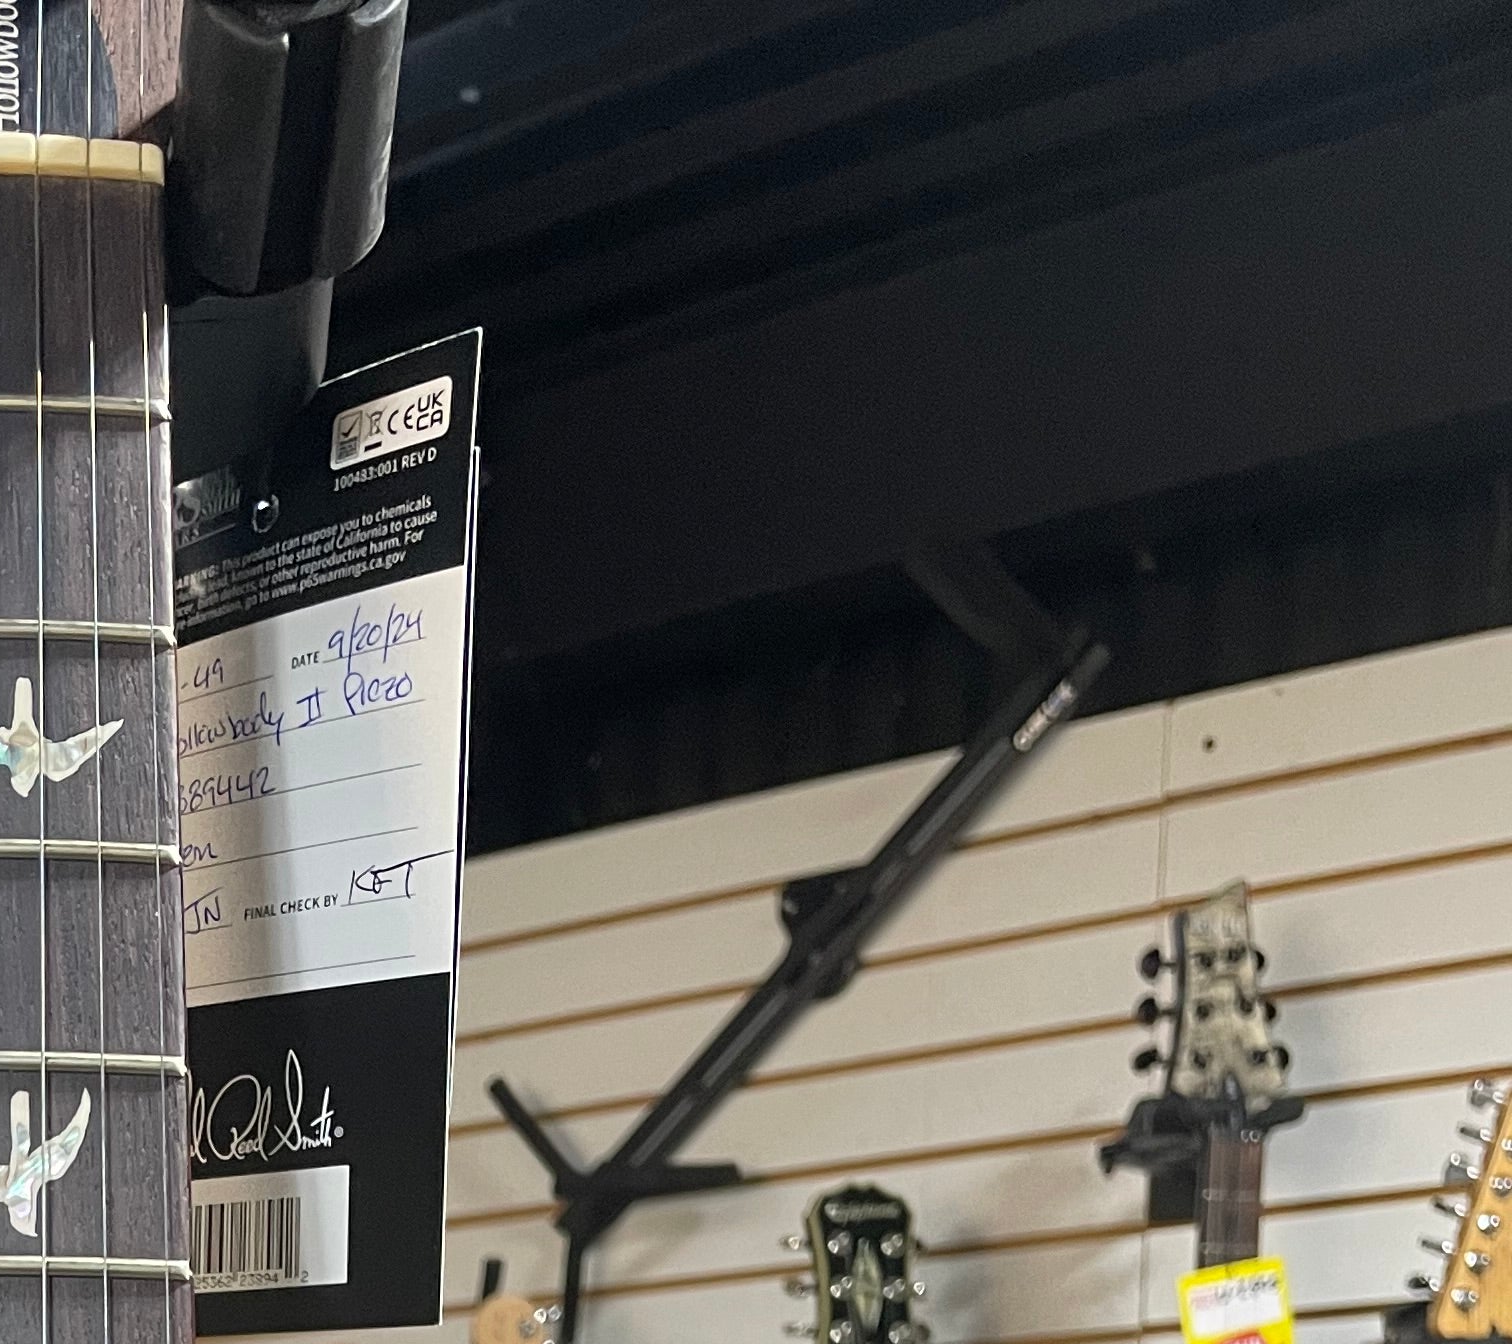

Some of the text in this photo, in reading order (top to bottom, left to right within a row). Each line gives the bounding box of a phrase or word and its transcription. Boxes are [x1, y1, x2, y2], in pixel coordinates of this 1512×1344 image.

[418, 389, 445, 412] UK
[417, 410, 443, 432] CA
[401, 449, 426, 470] REV
[427, 447, 437, 462] D
[301, 524, 338, 548] expose
[362, 514, 374, 527] to
[375, 494, 432, 522] chemicals
[336, 523, 388, 550] California
[389, 519, 403, 533] to
[404, 510, 438, 530] cause
[300, 546, 368, 576] reproductive
[404, 528, 424, 546] For
[329, 604, 424, 674] 9/20/24
[292, 651, 320, 669] DATE
[244, 893, 338, 921] FINAL CHECK BY
